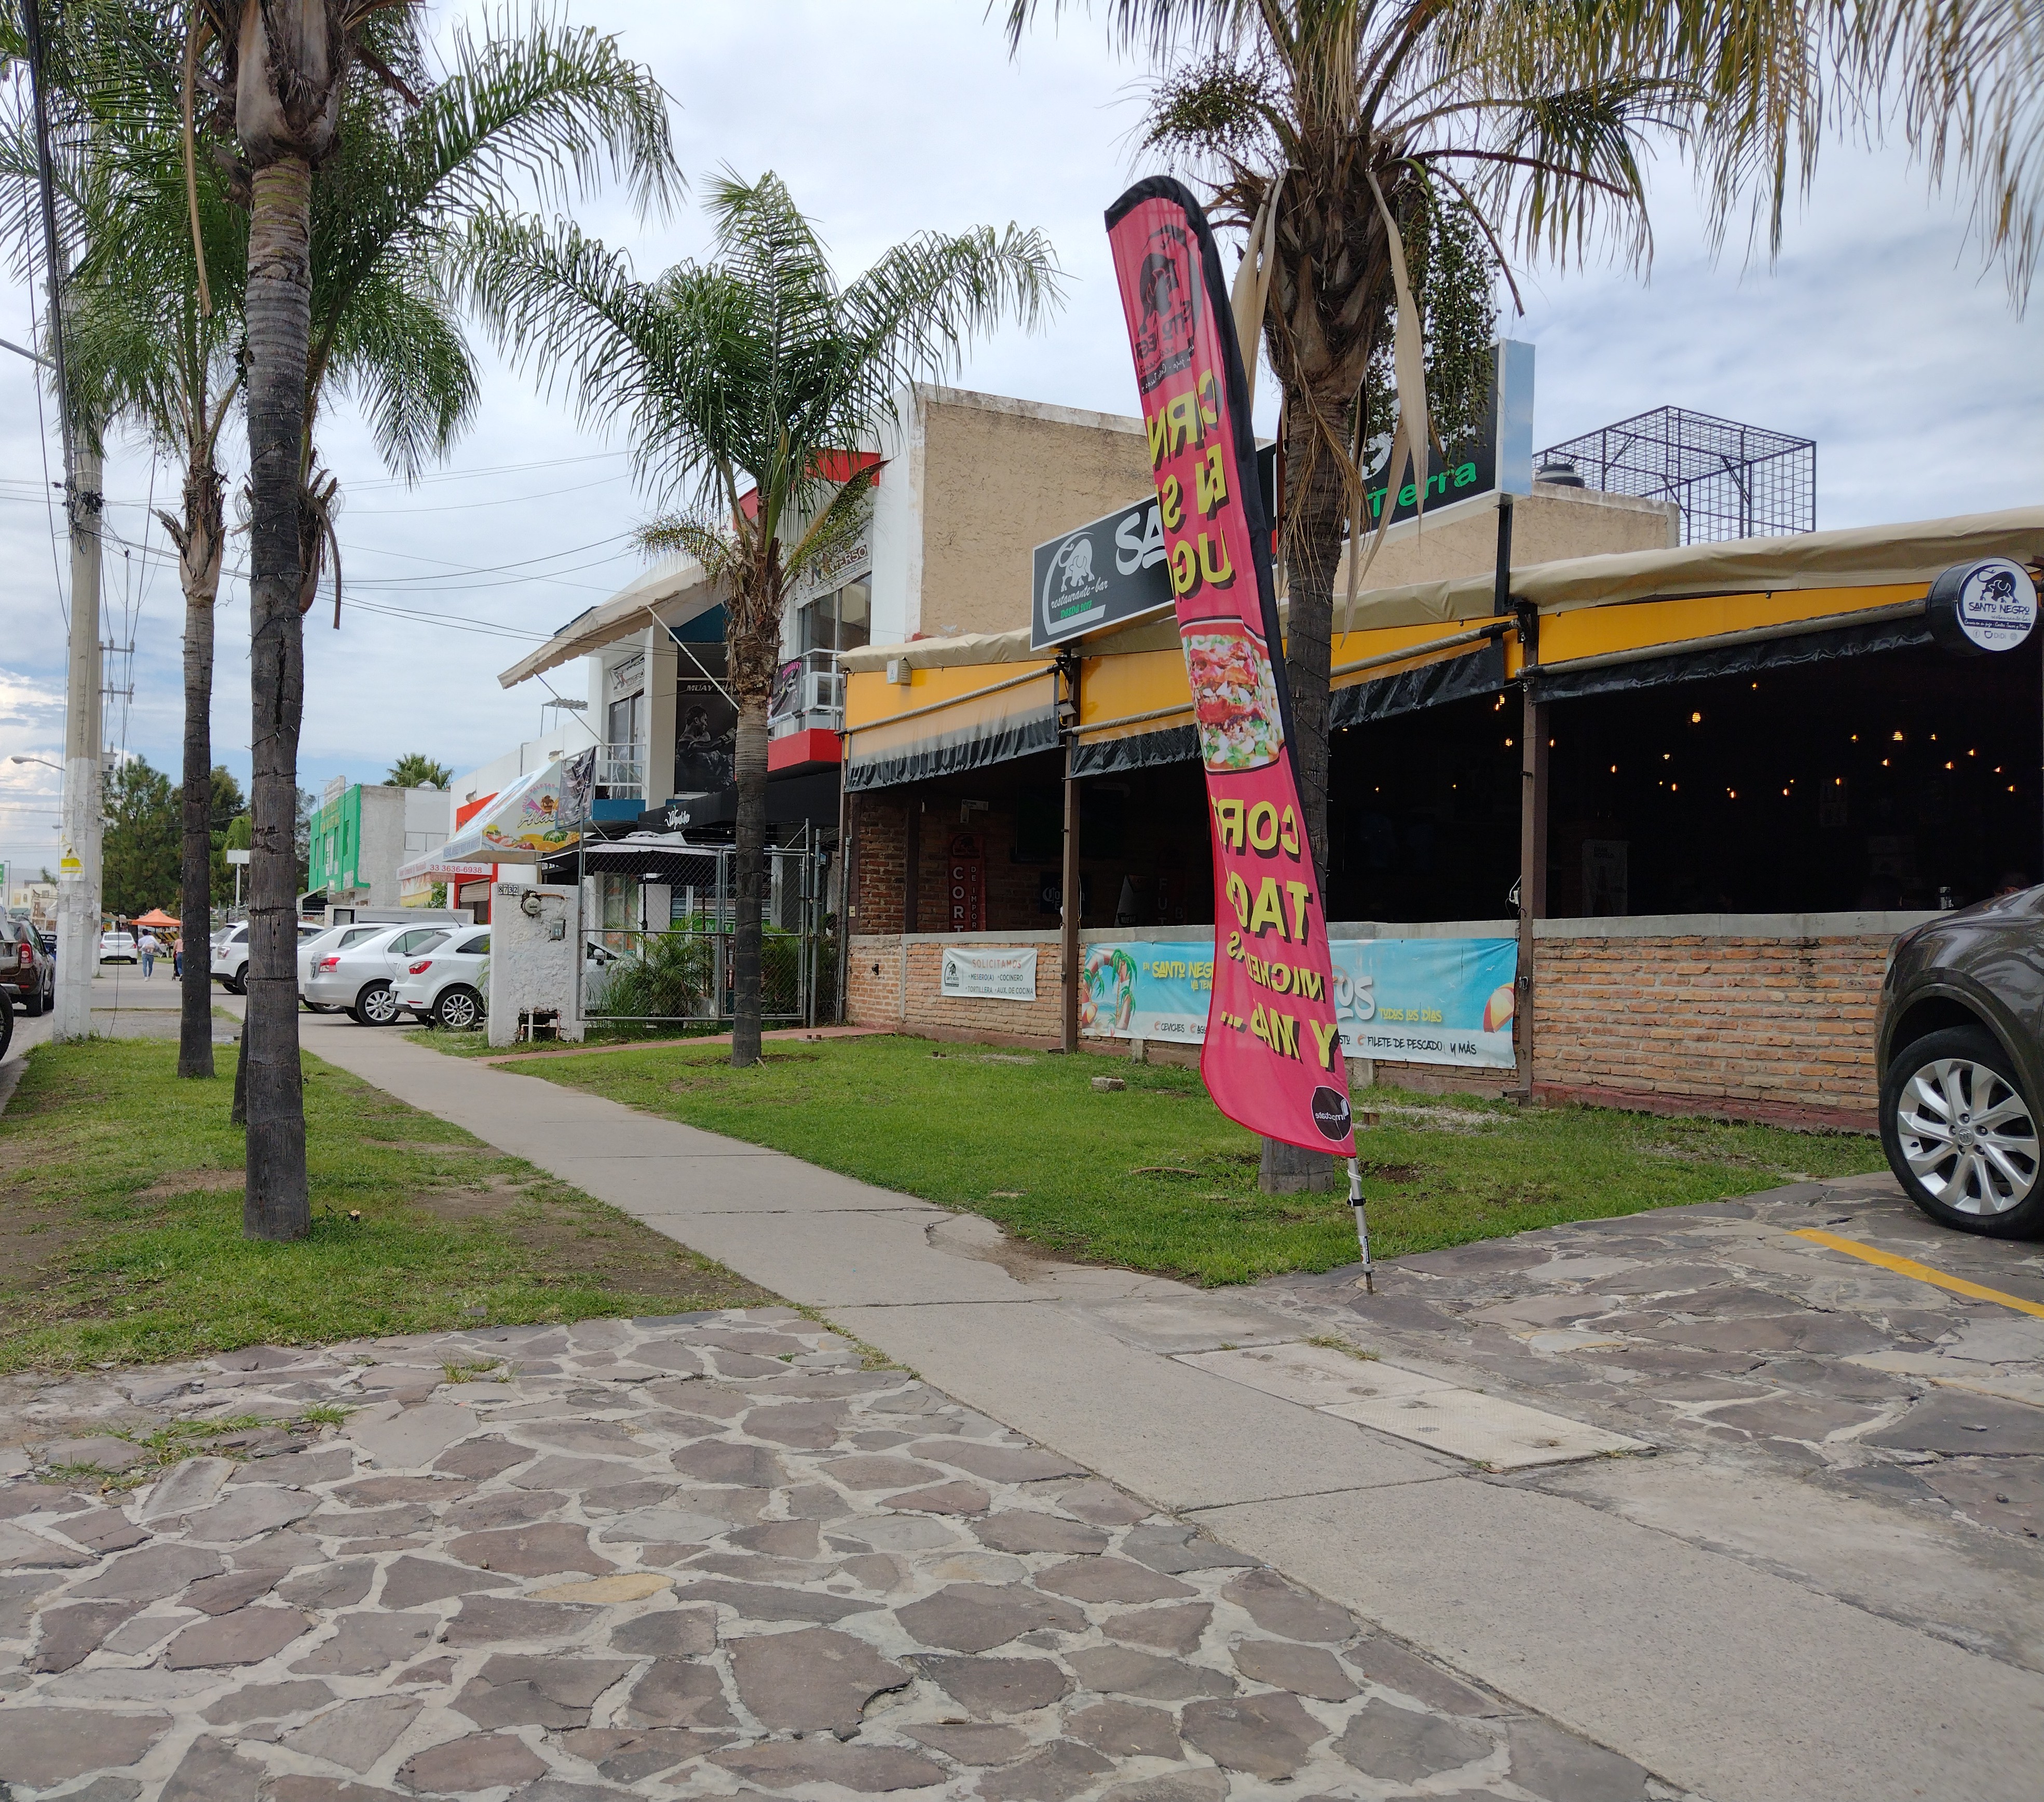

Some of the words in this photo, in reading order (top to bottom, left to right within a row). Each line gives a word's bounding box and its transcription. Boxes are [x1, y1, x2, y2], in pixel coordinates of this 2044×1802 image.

[1368, 462, 1477, 517] Terra
[1968, 602, 1996, 613] SANTO
[1999, 604, 2030, 615] NEGRO
[441, 865, 482, 874] 3636-6938
[972, 959, 1021, 969] SOLICITAMOS
[1143, 962, 1150, 971] EN
[1152, 961, 1185, 978] SANTO
[971, 973, 994, 981] MESERO(A)
[1000, 974, 1024, 982] COCINERO
[968, 986, 993, 994] TORTILLERA
[1378, 1008, 1404, 1021] TODOS
[1406, 1008, 1419, 1021] LOS
[1160, 1023, 1185, 1033] CEVICHES
[1367, 1036, 1392, 1048] FILETE
[1393, 1038, 1406, 1048] DE
[1407, 1039, 1443, 1052] PESCADO
[1450, 1042, 1457, 1057] Y
